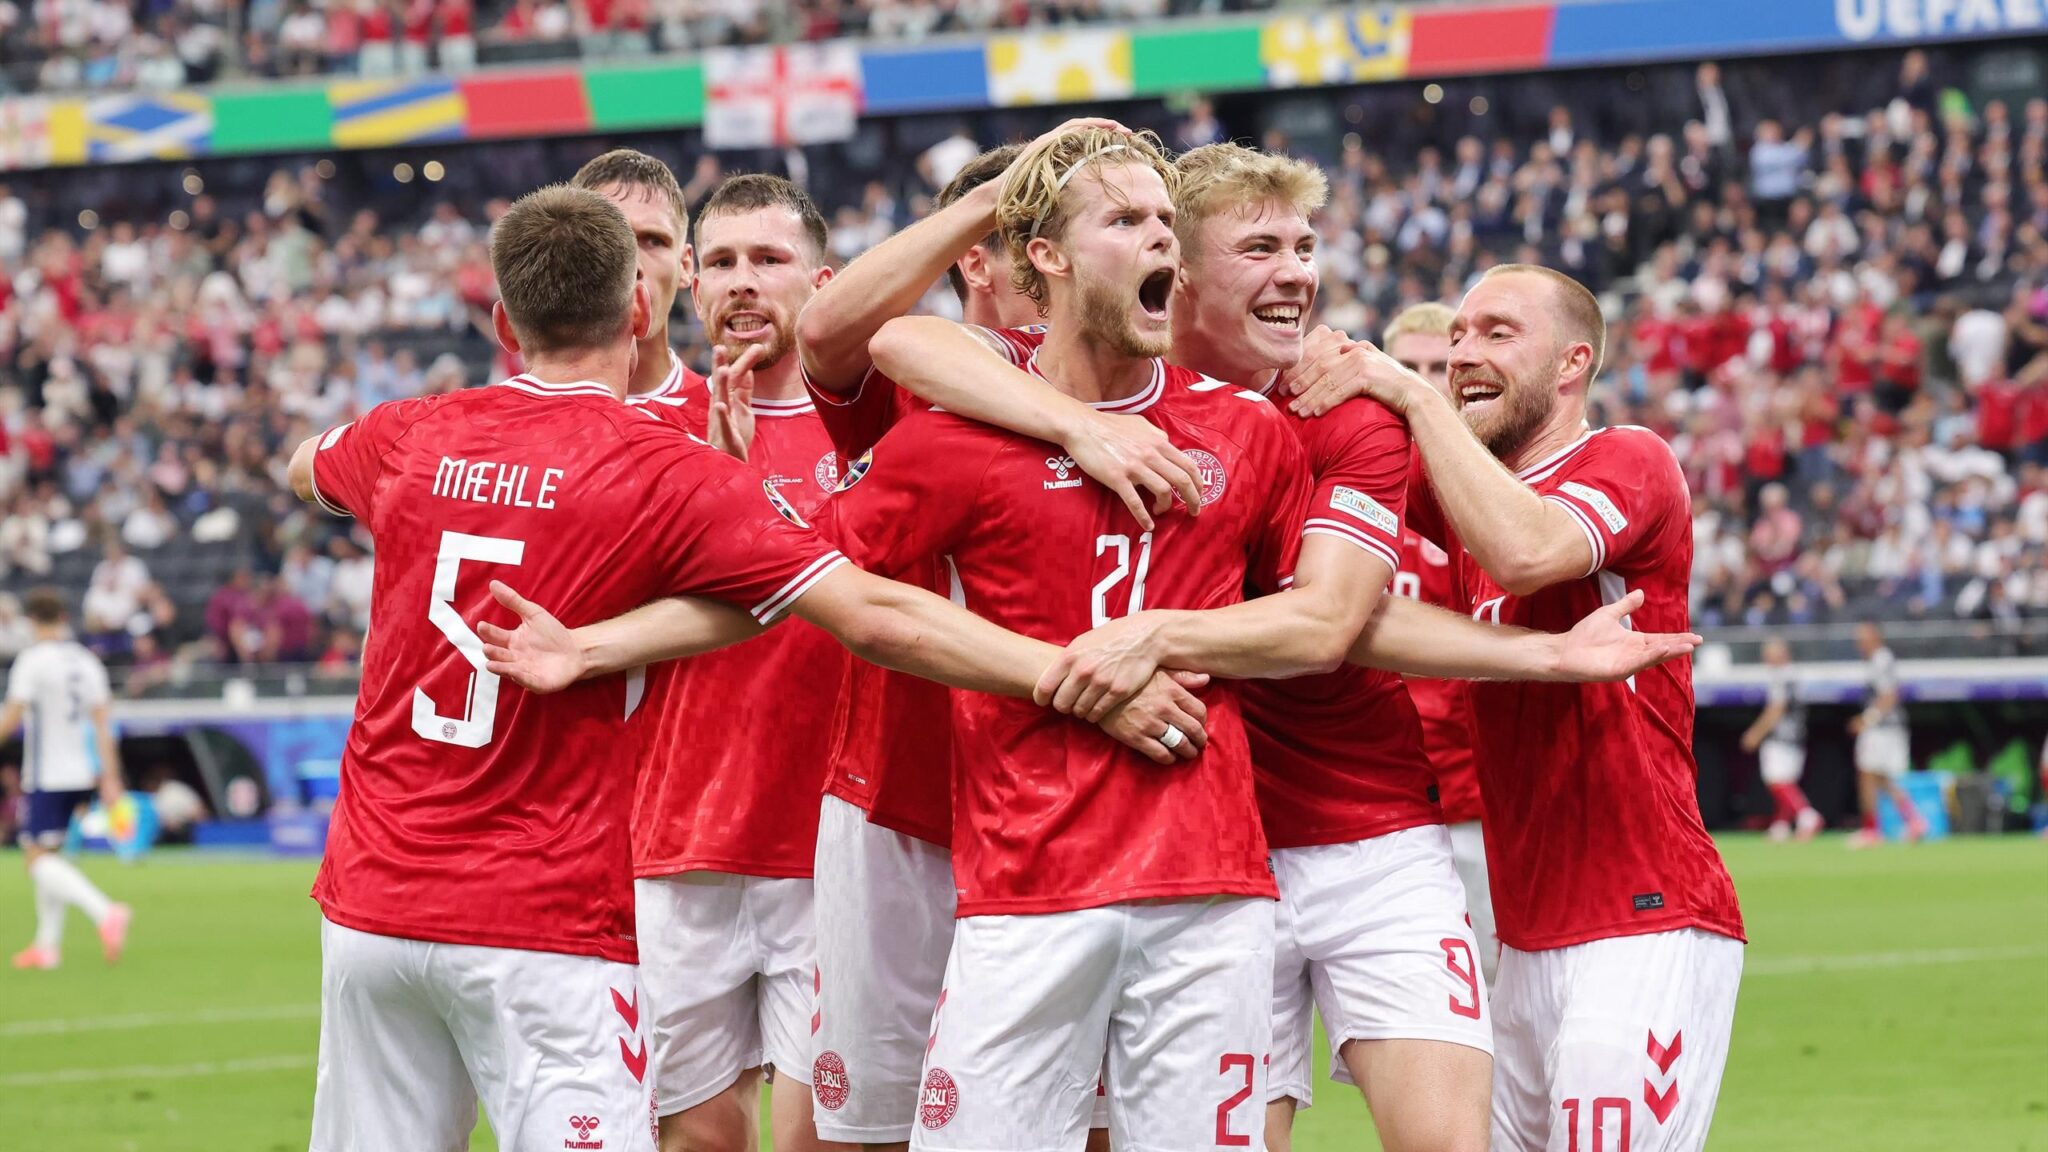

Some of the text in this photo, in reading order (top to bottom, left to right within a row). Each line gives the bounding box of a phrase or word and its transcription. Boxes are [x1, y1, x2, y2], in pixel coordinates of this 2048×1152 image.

[432, 455, 564, 510] MÆHLE
[1043, 477, 1083, 490] hummel
[1209, 468, 1223, 499] UNION
[1335, 487, 1354, 496] UEFA
[1333, 492, 1397, 530] FOUNDATION
[1091, 531, 1153, 630] 21
[411, 530, 525, 749] 5
[1440, 938, 1480, 1020] 9
[820, 1070, 843, 1089] DBU
[924, 1087, 947, 1107] DBU
[942, 1087, 957, 1121] UNION
[1216, 1053, 1270, 1146] 2
[1562, 1097, 1631, 1152] 10
[564, 1139, 603, 1150] hummel
